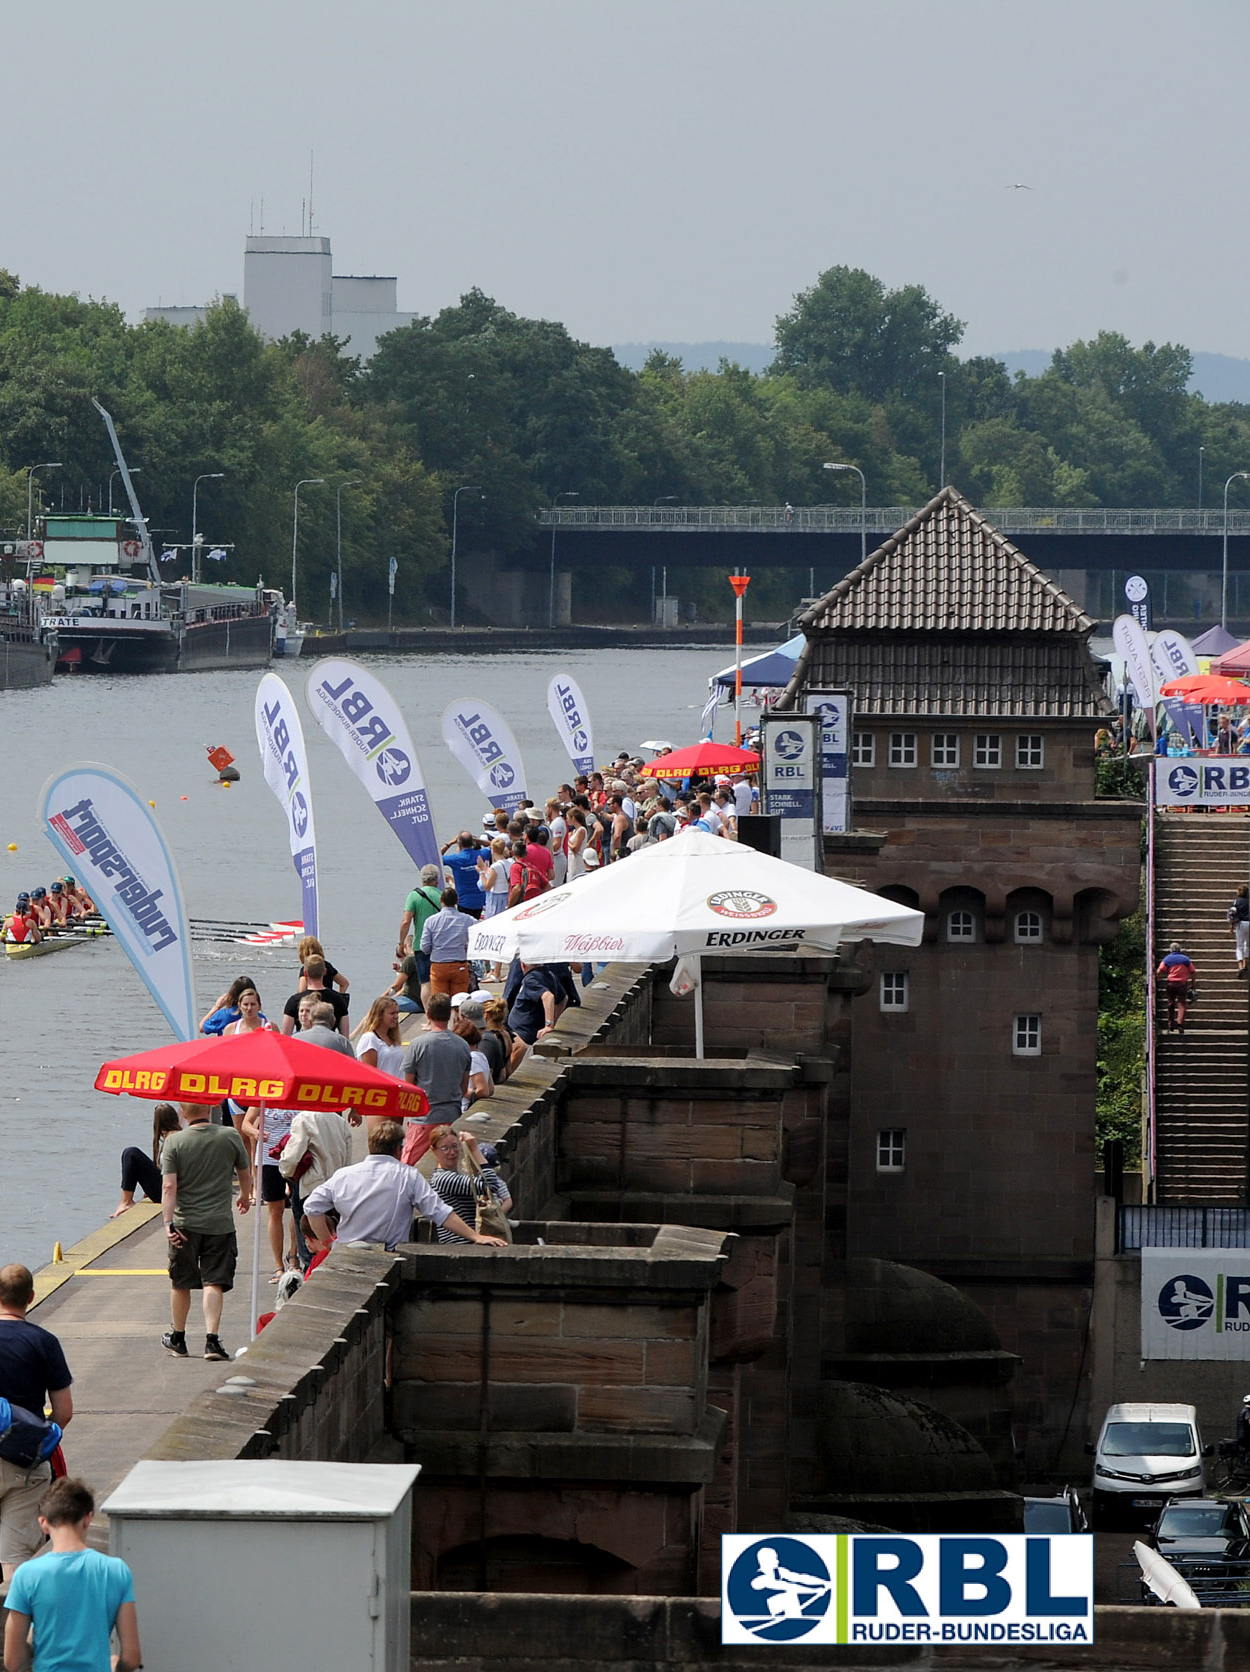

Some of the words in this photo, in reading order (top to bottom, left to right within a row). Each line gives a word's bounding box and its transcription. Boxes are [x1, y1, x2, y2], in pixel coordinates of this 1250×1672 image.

[822, 734, 839, 742] BL
[656, 768, 692, 778] DLRG
[698, 764, 740, 775] DLRG
[774, 766, 804, 777] RBL
[710, 891, 768, 906] ERDINGER
[564, 934, 625, 955] Weißbier
[706, 930, 806, 946] ERDINGER
[104, 1070, 166, 1090] DLRG
[180, 1074, 284, 1098] DLRG
[297, 1084, 388, 1106] DLRG
